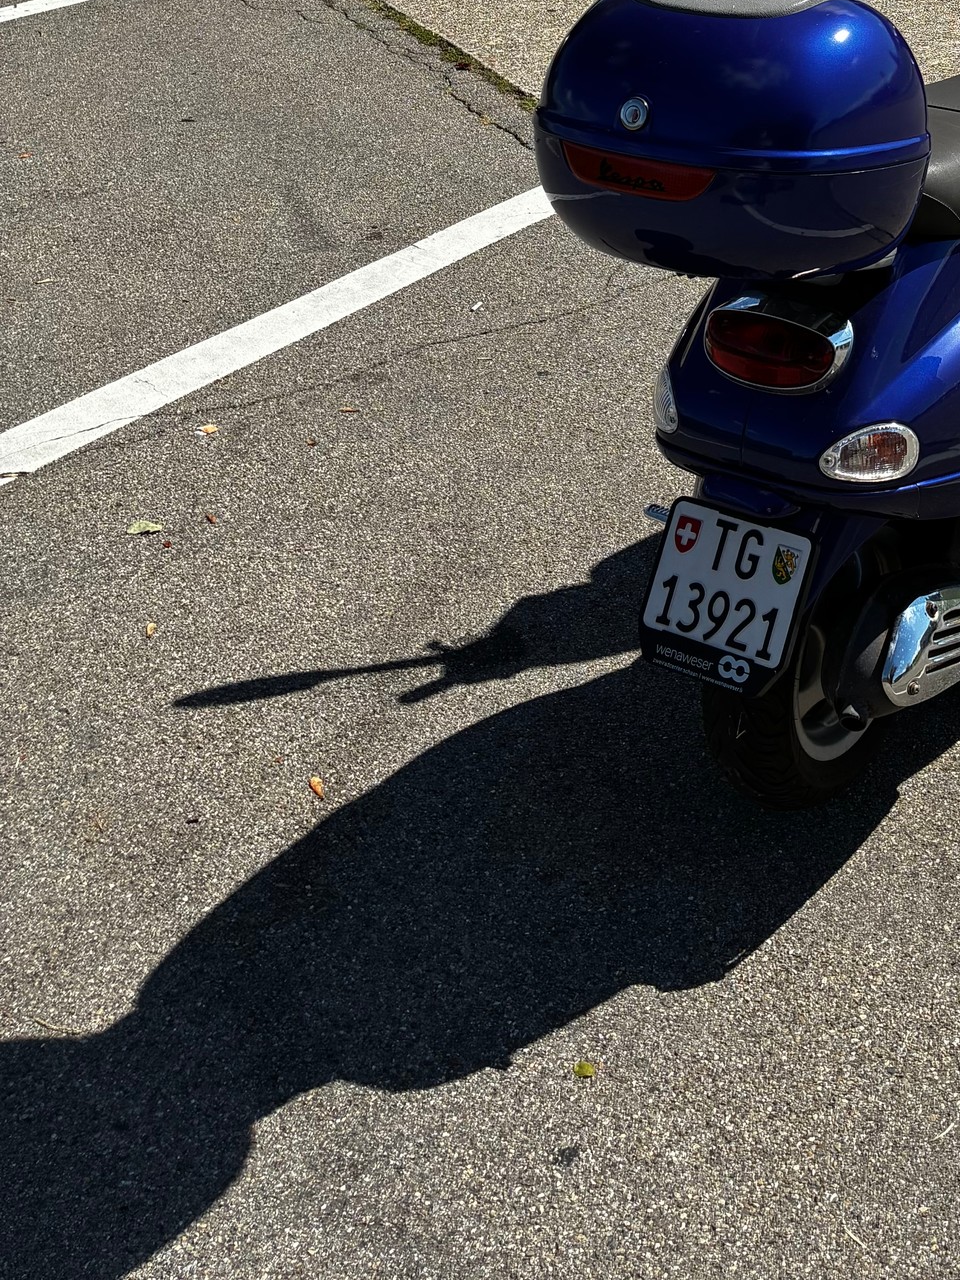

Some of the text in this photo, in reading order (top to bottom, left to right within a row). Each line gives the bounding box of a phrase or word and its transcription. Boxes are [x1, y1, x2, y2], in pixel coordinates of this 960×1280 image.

[598, 157, 665, 192] Vespa
[712, 518, 764, 580] TG
[655, 574, 779, 662] 13921
[655, 643, 714, 671] wenaweser
